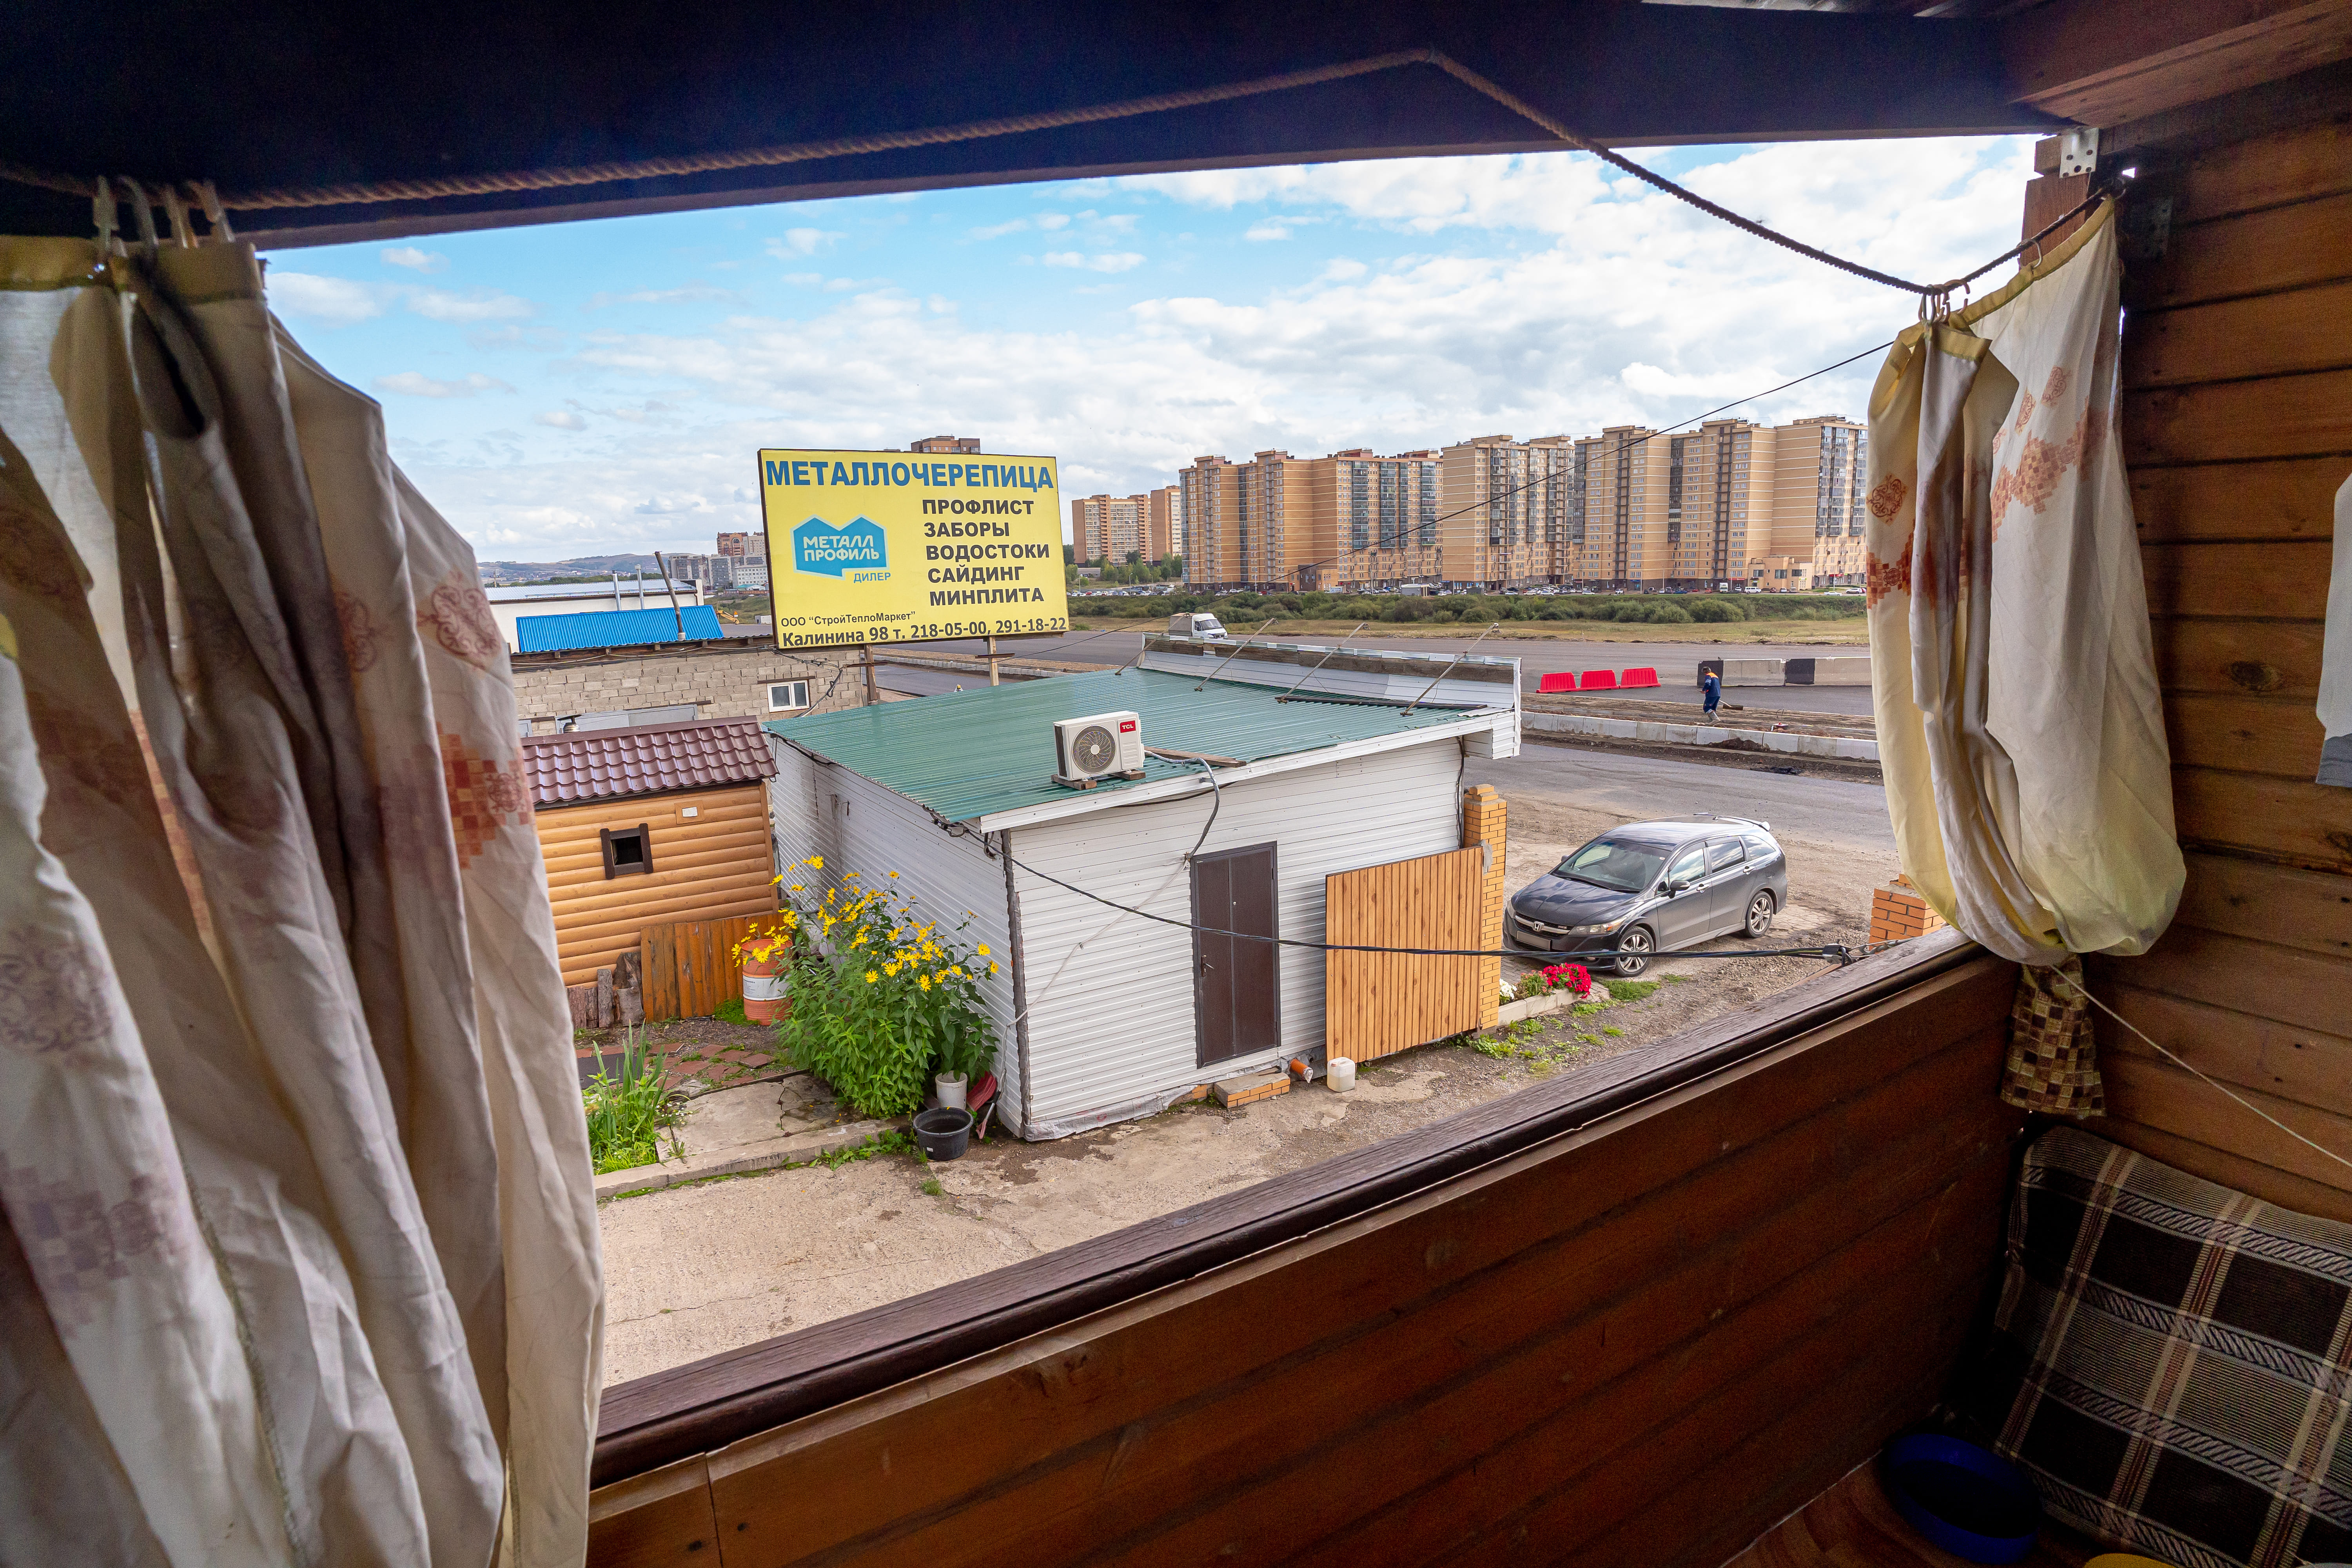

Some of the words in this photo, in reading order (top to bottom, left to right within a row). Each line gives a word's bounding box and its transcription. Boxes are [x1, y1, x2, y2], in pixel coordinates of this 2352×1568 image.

[766, 461, 1054, 493] МЕТАЛЛОЧЕРЕПИЦА
[922, 499, 1034, 515] ПРОФЛИСТ
[924, 522, 1009, 537] ЗАБОРЫ
[803, 535, 874, 549] МЕТАЛЛ
[804, 548, 880, 561] ПРОФИЛЬ
[926, 544, 1049, 563] ВОДОСТОКИ
[853, 572, 891, 583] ДИЛЕР
[928, 564, 1024, 585] САЙДИНГ
[929, 588, 1044, 606] МИНПЛИТА
[781, 617, 806, 627] ООО
[783, 631, 864, 647] Калинина
[869, 626, 889, 641] 98
[893, 629, 905, 639] т.
[911, 621, 991, 638] 218-05-00,
[996, 617, 1066, 633] 291-18-22
